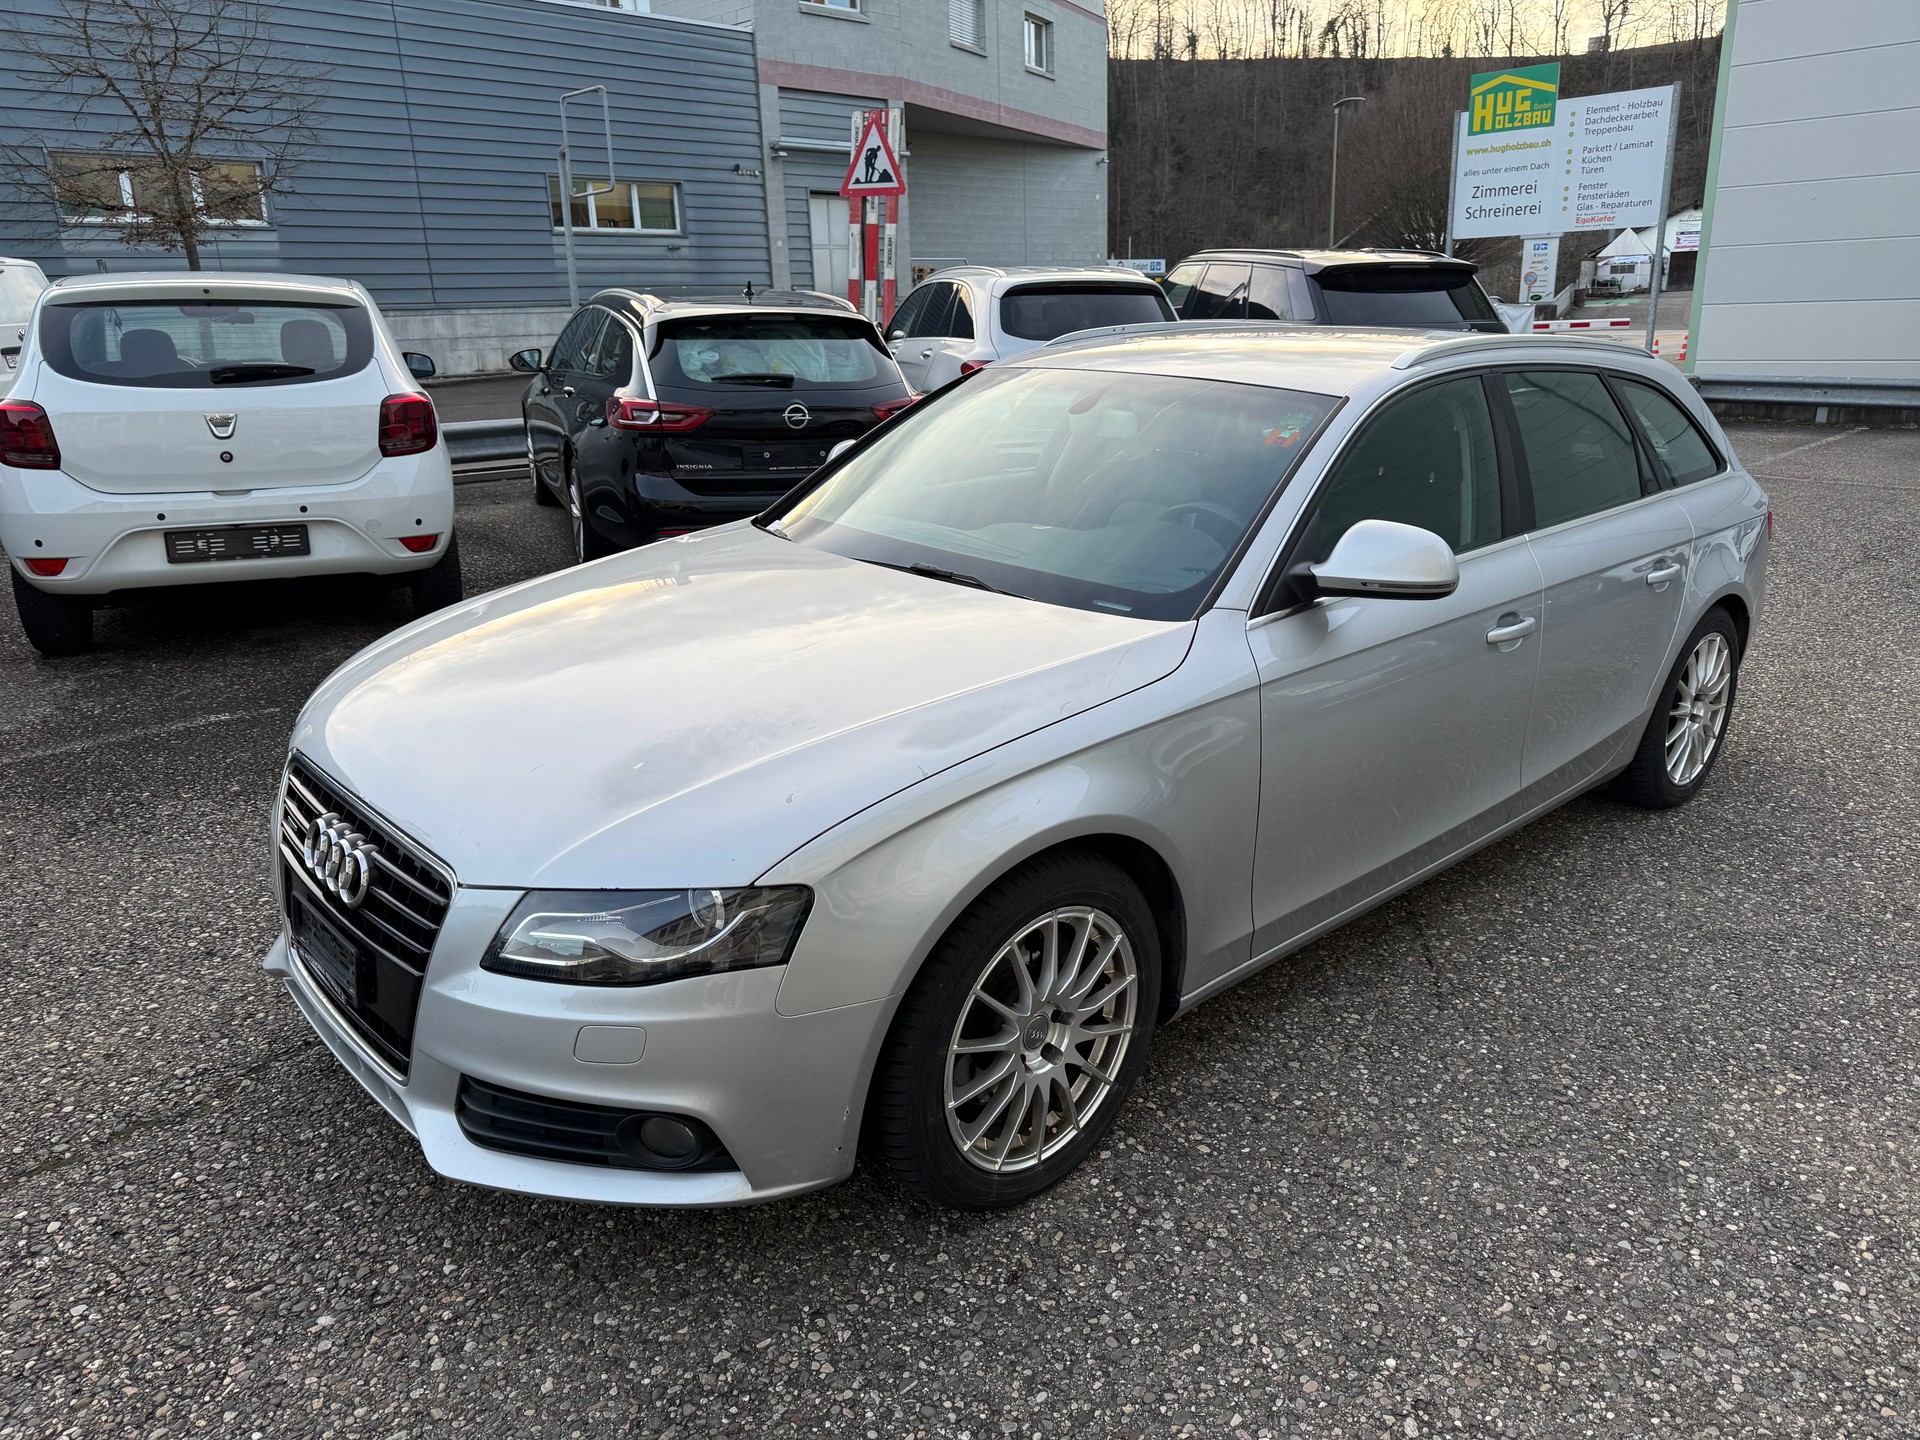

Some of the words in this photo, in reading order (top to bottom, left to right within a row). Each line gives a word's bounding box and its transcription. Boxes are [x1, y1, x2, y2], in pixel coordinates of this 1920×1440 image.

[1534, 102, 1552, 110] GmbH
[1586, 104, 1620, 115] Element
[1627, 99, 1664, 110] Holzbau
[1585, 110, 1659, 126] Dachdeckerarbeit
[1584, 124, 1634, 136] Treppenbau
[1466, 139, 1552, 155] www.hugholzbau.ch
[1582, 143, 1612, 154] Parkett
[1619, 140, 1654, 151] Laminat
[1581, 154, 1612, 164] Küchen
[1463, 169, 1481, 177] alles
[1481, 167, 1502, 175] unter
[1504, 165, 1528, 173] einem
[1530, 161, 1550, 171] Dach
[1581, 166, 1605, 175] Türen
[1472, 180, 1538, 199] Zimmerei
[1578, 182, 1608, 191] Fenster
[1577, 190, 1630, 201] Fensterläden
[1465, 200, 1542, 220] Schreinerei
[1576, 203, 1594, 212] Glas
[1600, 199, 1653, 210] Reparaturen
[1575, 215, 1616, 225] EgoKiefer
